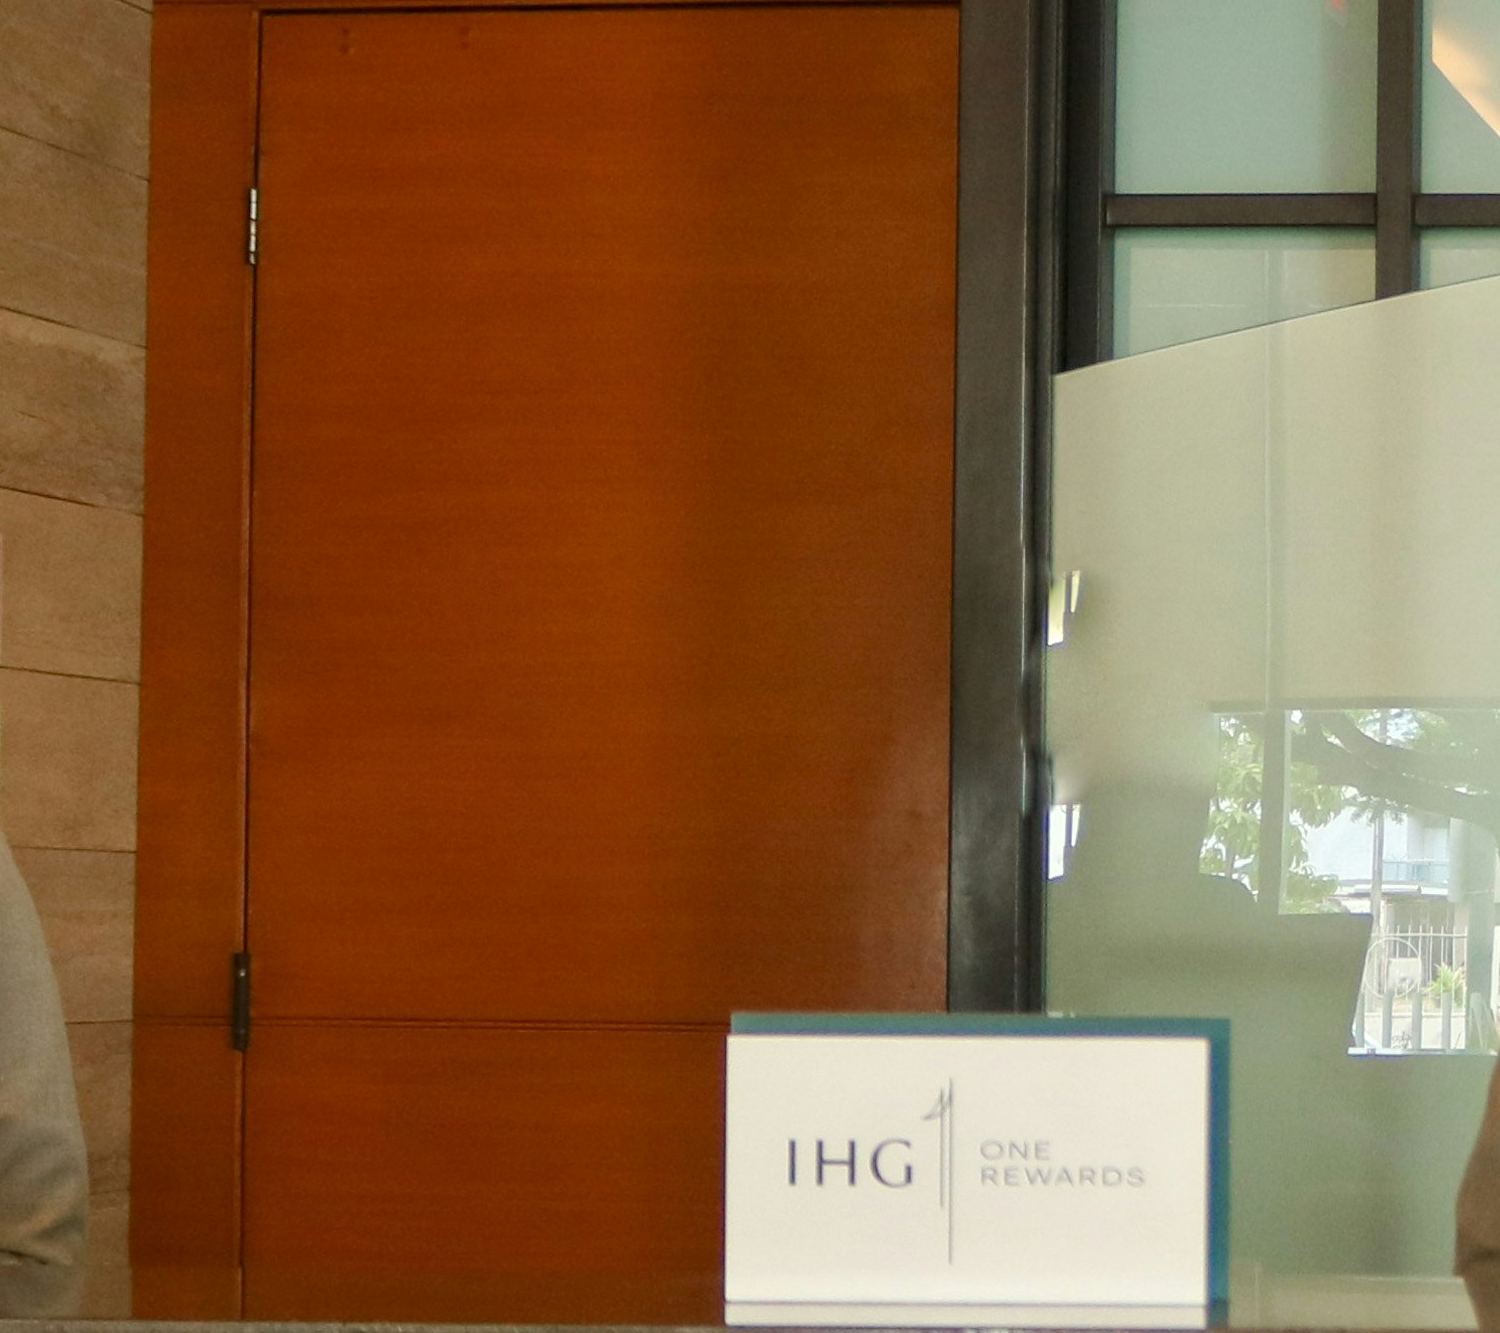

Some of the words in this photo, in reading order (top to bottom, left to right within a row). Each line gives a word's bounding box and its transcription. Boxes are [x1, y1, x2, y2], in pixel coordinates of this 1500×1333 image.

[979, 1139, 1052, 1161] ONE
[787, 1138, 914, 1189] IHG
[979, 1166, 1147, 1188] REWARDS
